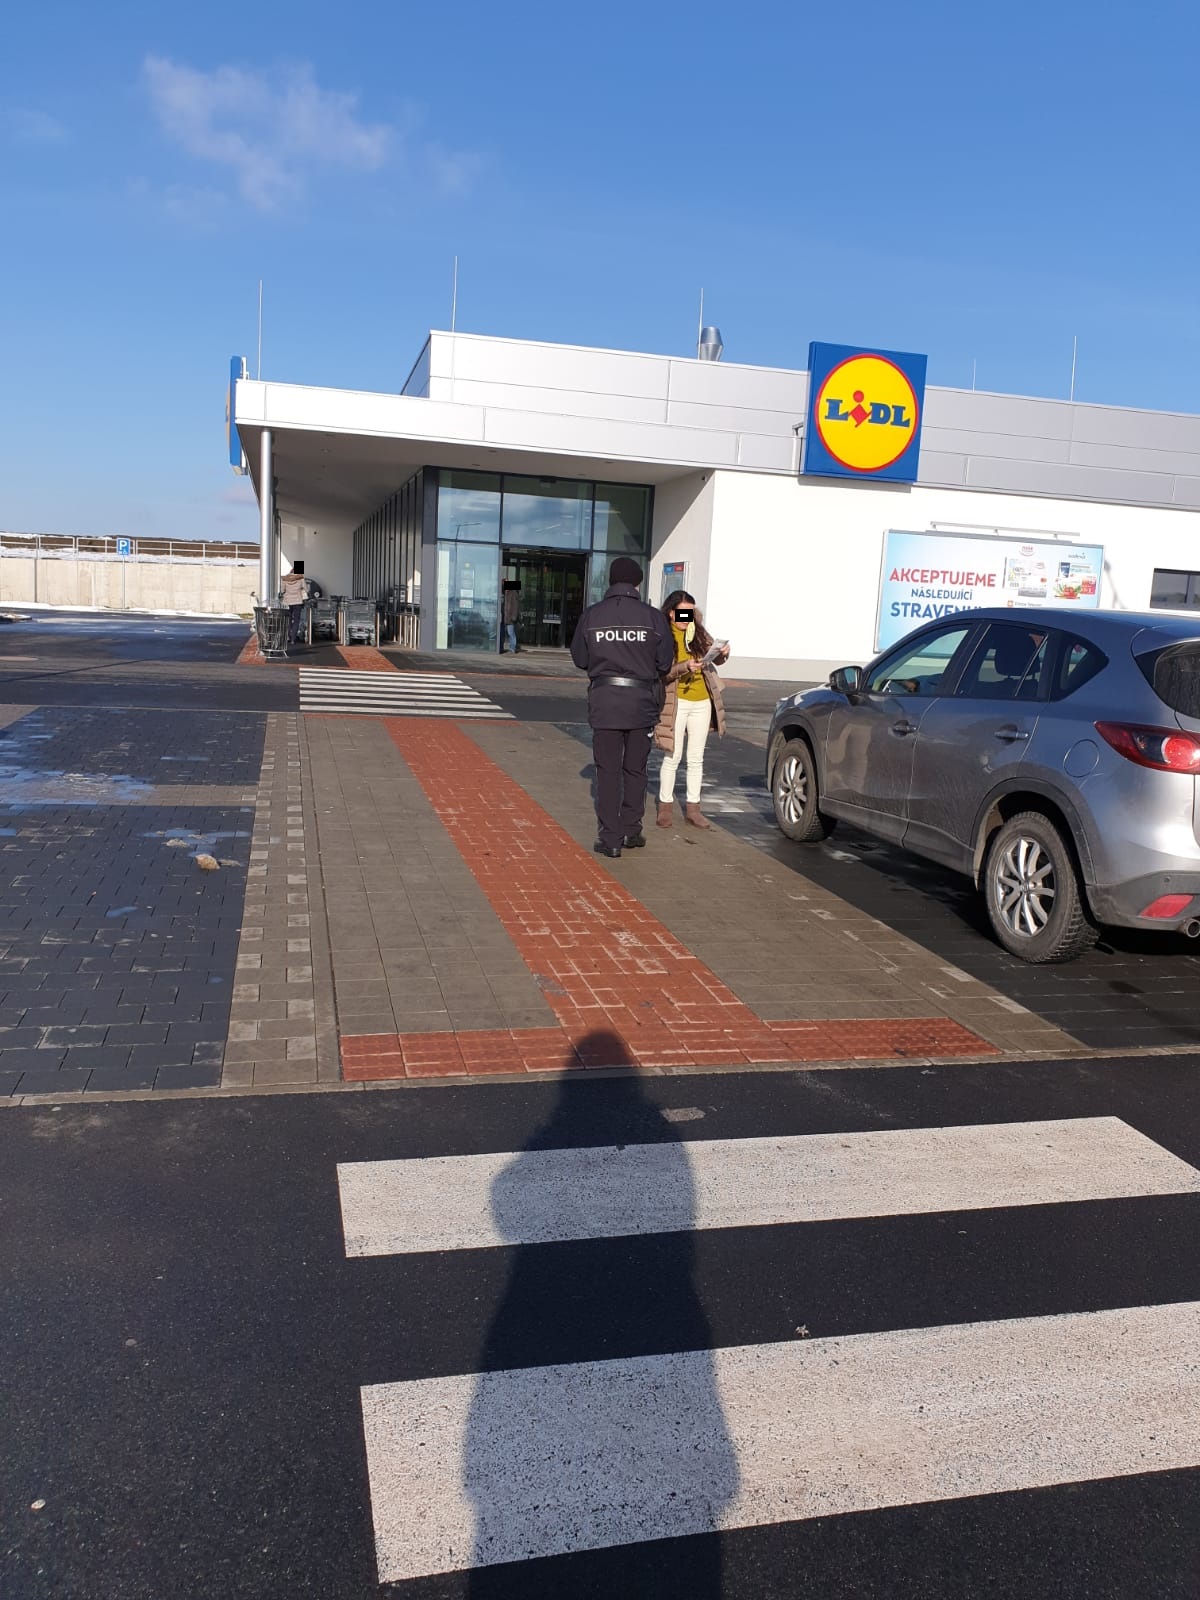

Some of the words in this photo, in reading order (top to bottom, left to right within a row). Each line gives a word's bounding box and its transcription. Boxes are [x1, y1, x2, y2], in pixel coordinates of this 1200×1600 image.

[119, 540, 127, 551] P
[889, 568, 997, 587] AKCEPTUJEME
[911, 586, 973, 600] NÁSLEDUJÍCÍ
[596, 630, 647, 642] POLICIE
